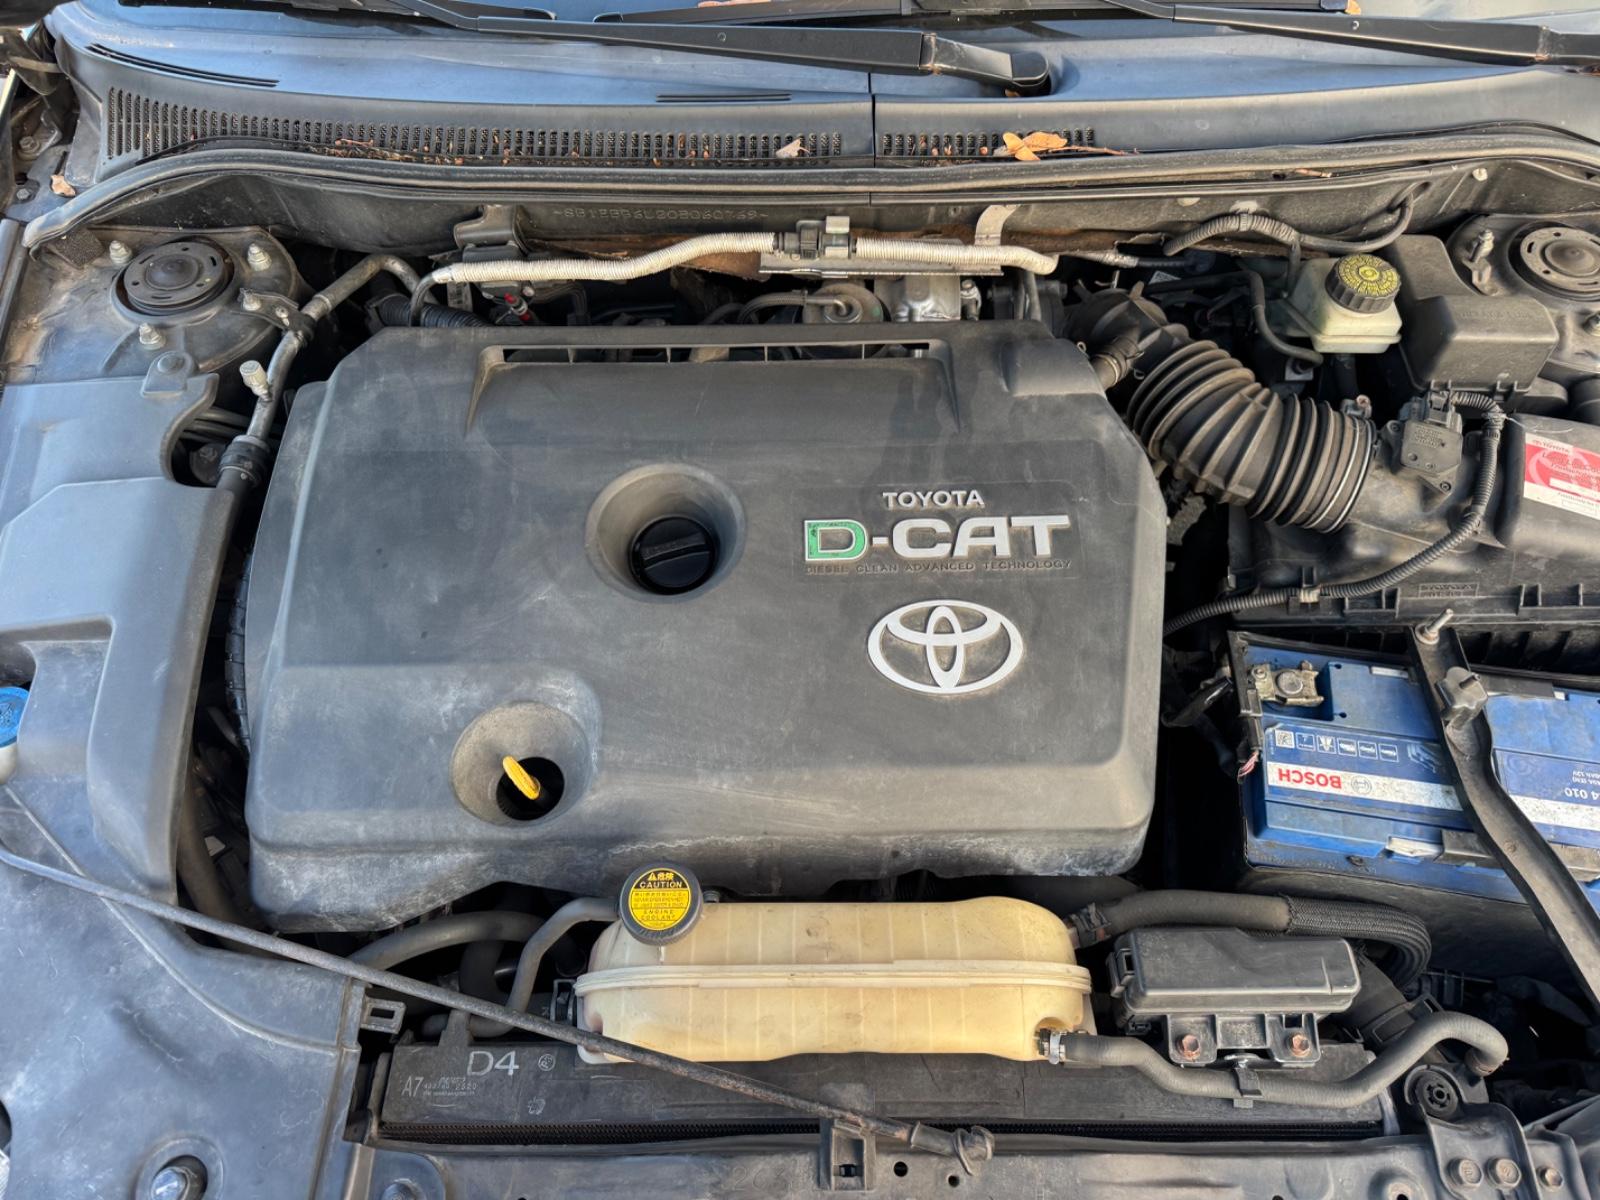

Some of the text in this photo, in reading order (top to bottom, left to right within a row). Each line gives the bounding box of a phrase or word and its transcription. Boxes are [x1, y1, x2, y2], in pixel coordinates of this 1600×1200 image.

[882, 489, 985, 509] TOYOTA
[804, 514, 1071, 562] D-CAT
[805, 559, 1072, 575] DIESEL CLEAN ADVANCED TECHNOLOGY
[1278, 768, 1342, 790] BOSCH
[1564, 787, 1588, 799] 010
[639, 881, 682, 889] CAUTION
[466, 1050, 520, 1076] D4
[401, 1075, 424, 1097] A7
